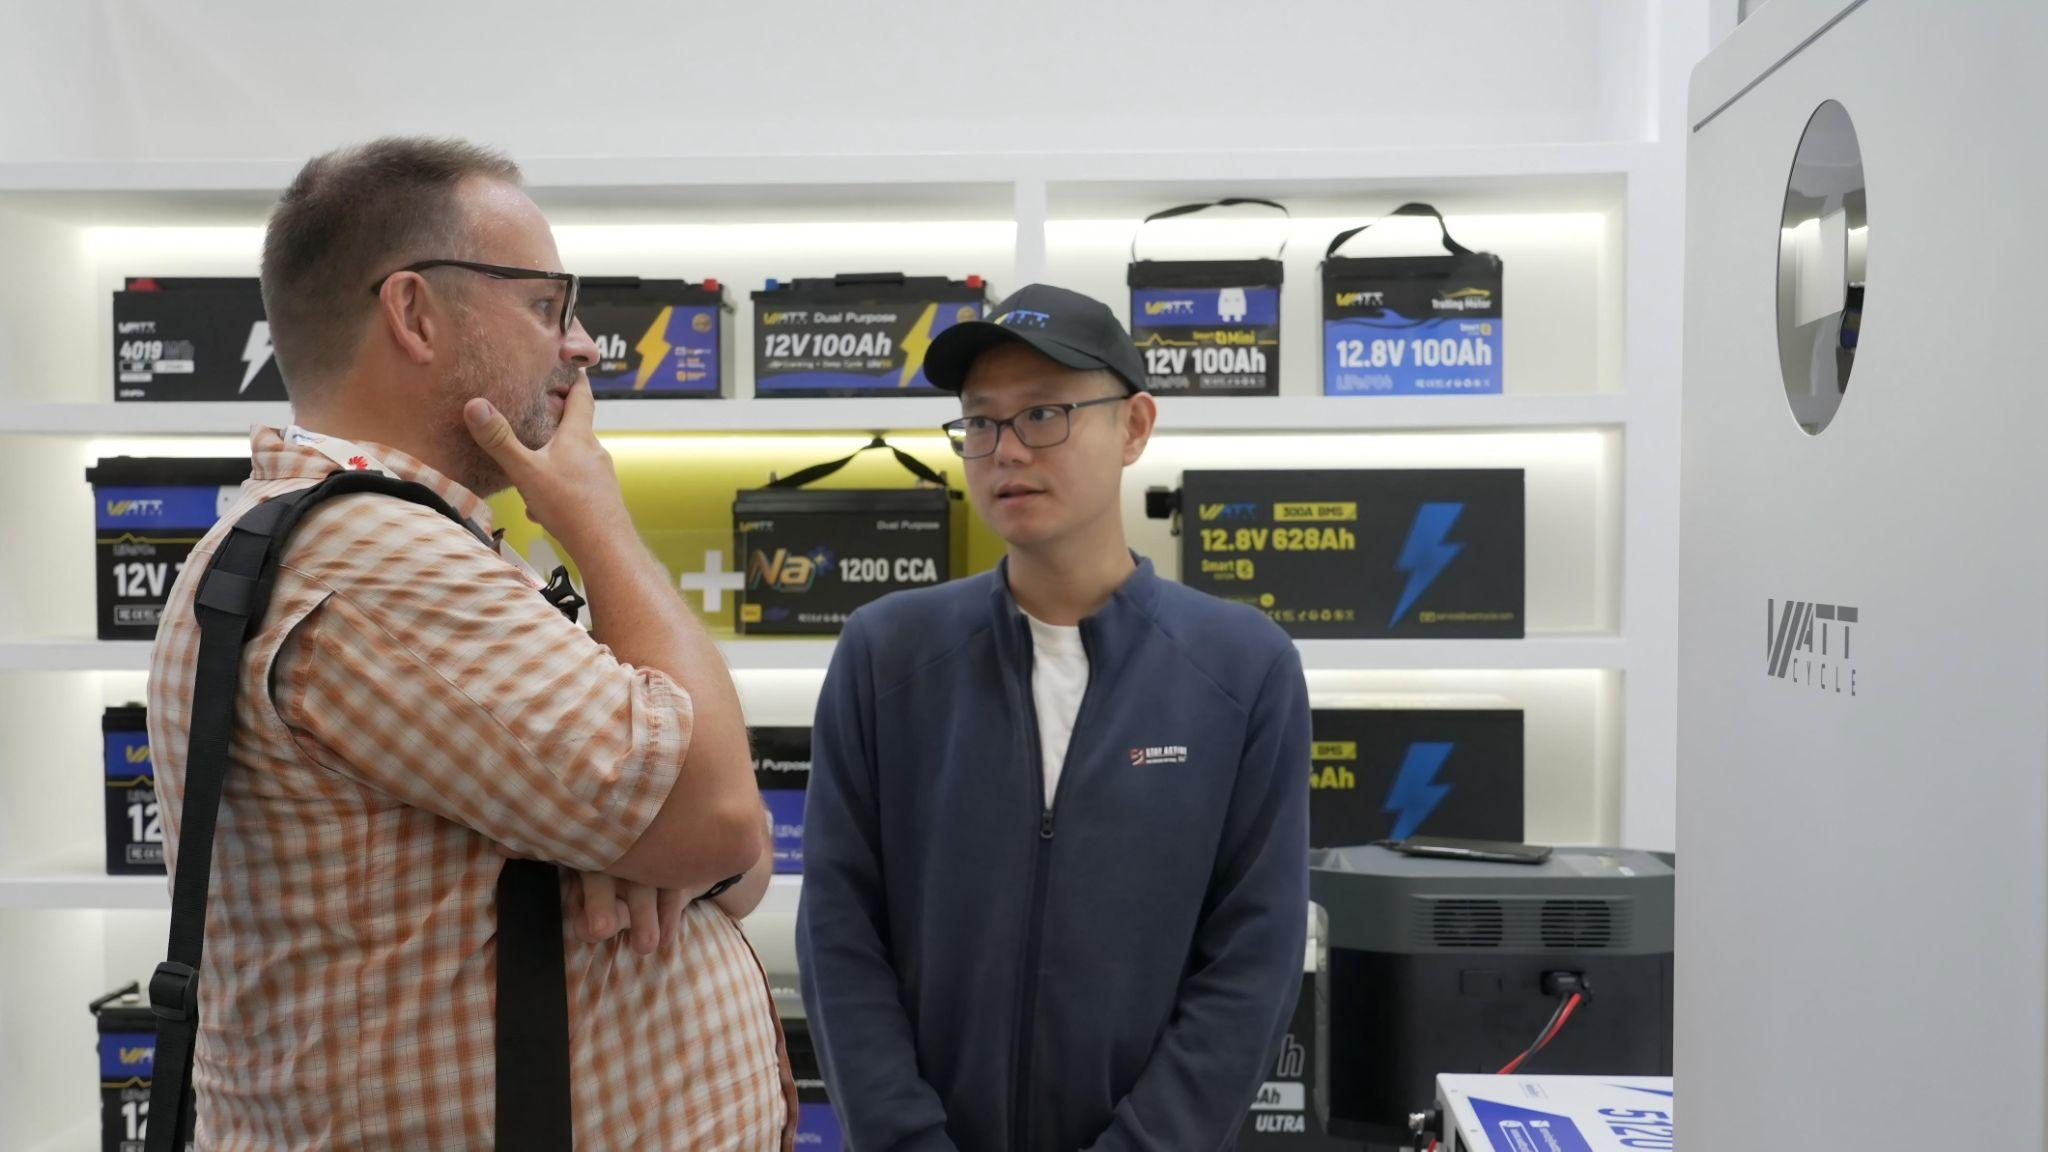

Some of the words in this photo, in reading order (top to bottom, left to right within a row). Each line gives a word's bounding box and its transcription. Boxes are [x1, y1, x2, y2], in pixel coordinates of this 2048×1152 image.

[814, 312, 843, 323] Dual
[845, 312, 897, 325] Purpose
[119, 340, 163, 361] 4019
[765, 333, 811, 357] 12V
[812, 331, 892, 357] 100Ah
[1336, 338, 1405, 368] 12.8V
[1411, 337, 1492, 368] 100Ah
[1145, 348, 1187, 375] 12V
[1191, 347, 1267, 374] 100Ah
[1200, 528, 1268, 551] 12.8V
[1272, 527, 1356, 551] 628Ah
[113, 562, 168, 597] 12V
[839, 557, 889, 582] 1200
[894, 557, 938, 582] CCA
[1767, 598, 1859, 679] WATT
[1793, 657, 1857, 697] CYCLE
[1255, 1114, 1306, 1133] ULTRA
